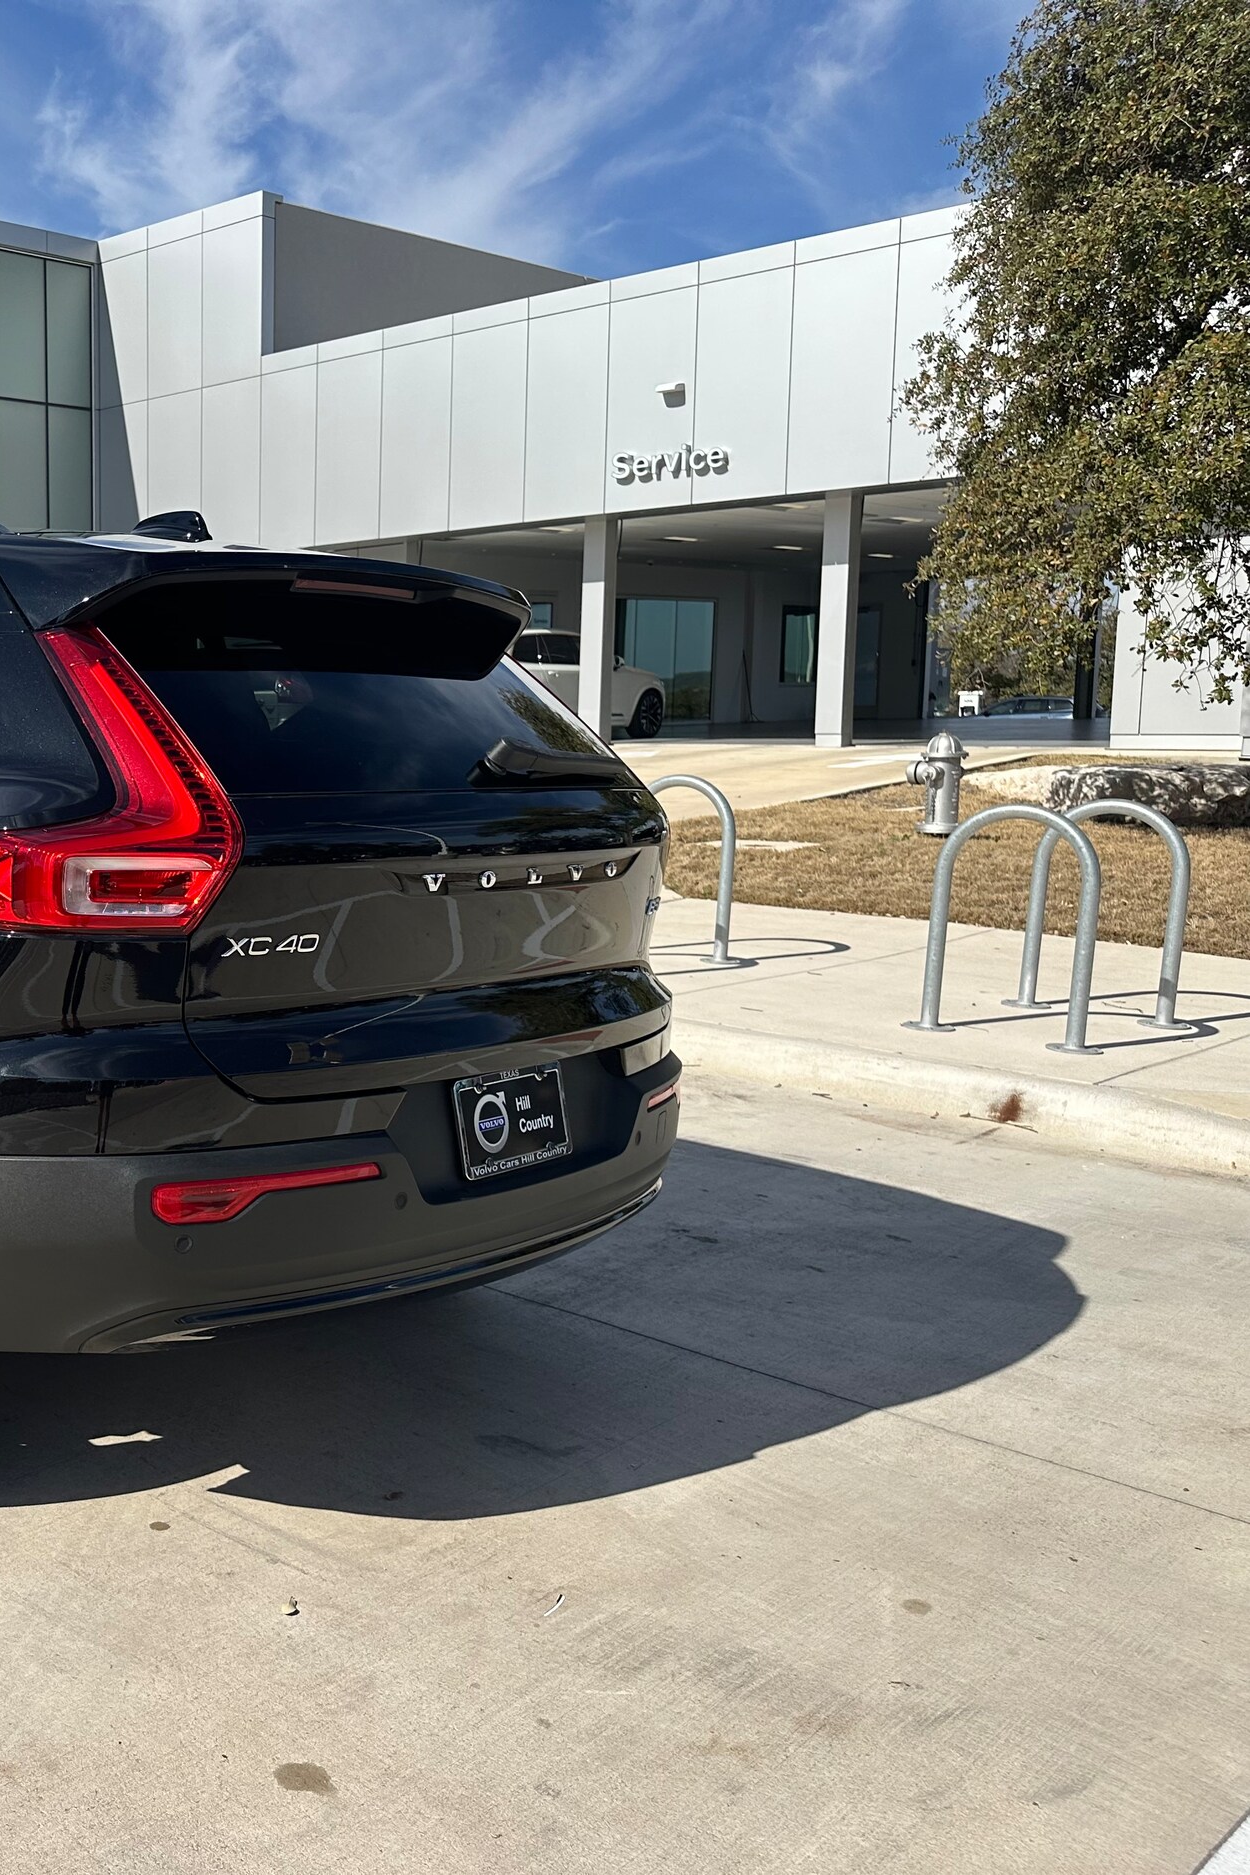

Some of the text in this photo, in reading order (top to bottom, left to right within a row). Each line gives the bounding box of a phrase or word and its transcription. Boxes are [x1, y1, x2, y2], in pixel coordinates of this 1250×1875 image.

[611, 443, 725, 479] Service
[422, 860, 618, 893] VOLVO
[499, 1069, 520, 1080] TEXAS
[515, 1094, 531, 1111] Hill
[480, 1118, 504, 1130] VOLVO
[519, 1114, 554, 1133] Country
[474, 1145, 567, 1176] Volvo Cars Hill Country
